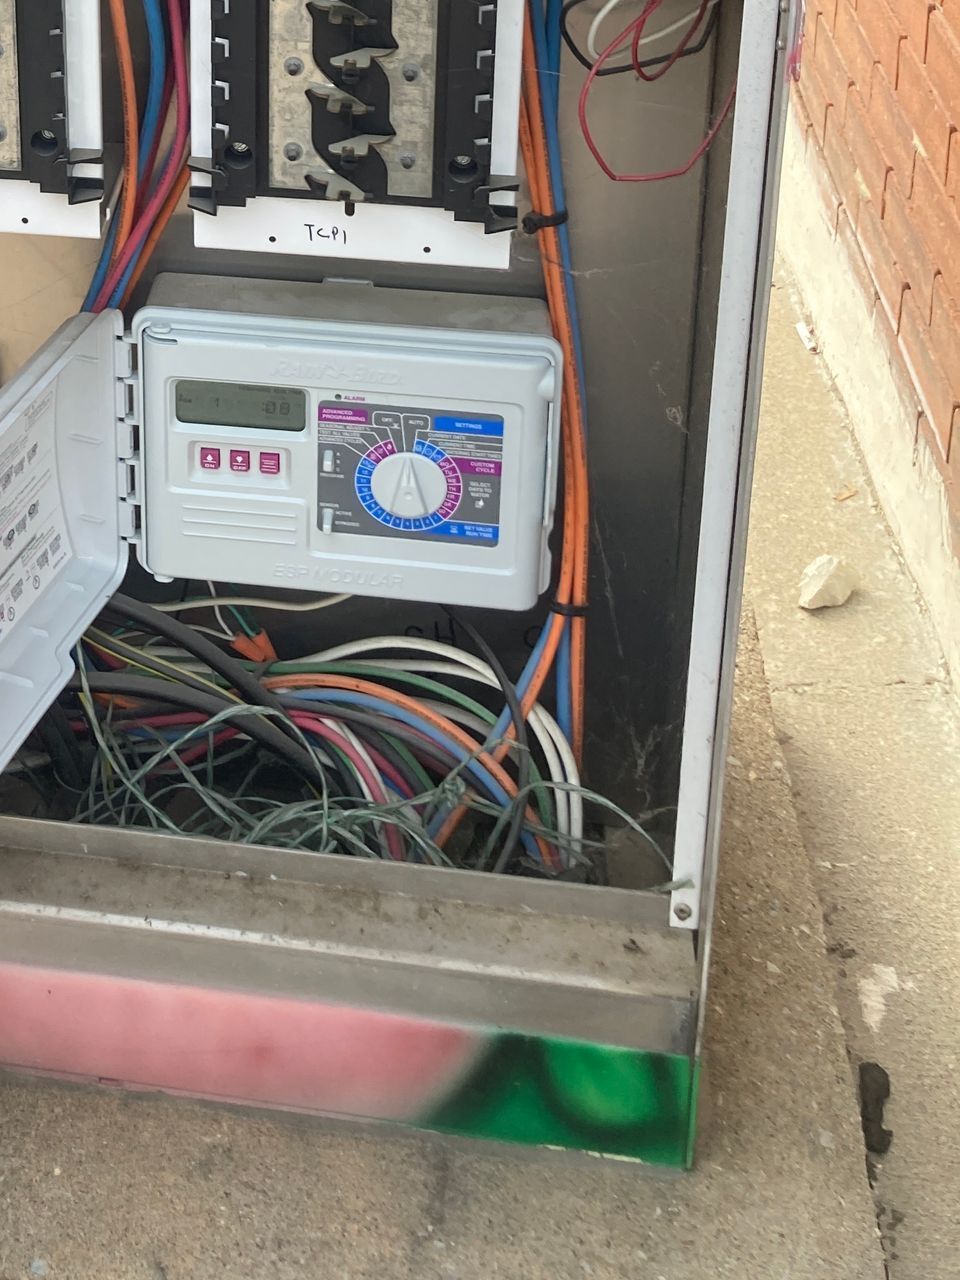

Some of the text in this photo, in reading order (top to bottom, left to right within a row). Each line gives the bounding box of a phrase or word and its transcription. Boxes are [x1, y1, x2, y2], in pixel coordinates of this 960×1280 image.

[321, 413, 366, 422] PROGRAMMING
[454, 422, 482, 430] SETTINGS
[273, 562, 404, 587] ESP MODULAR
